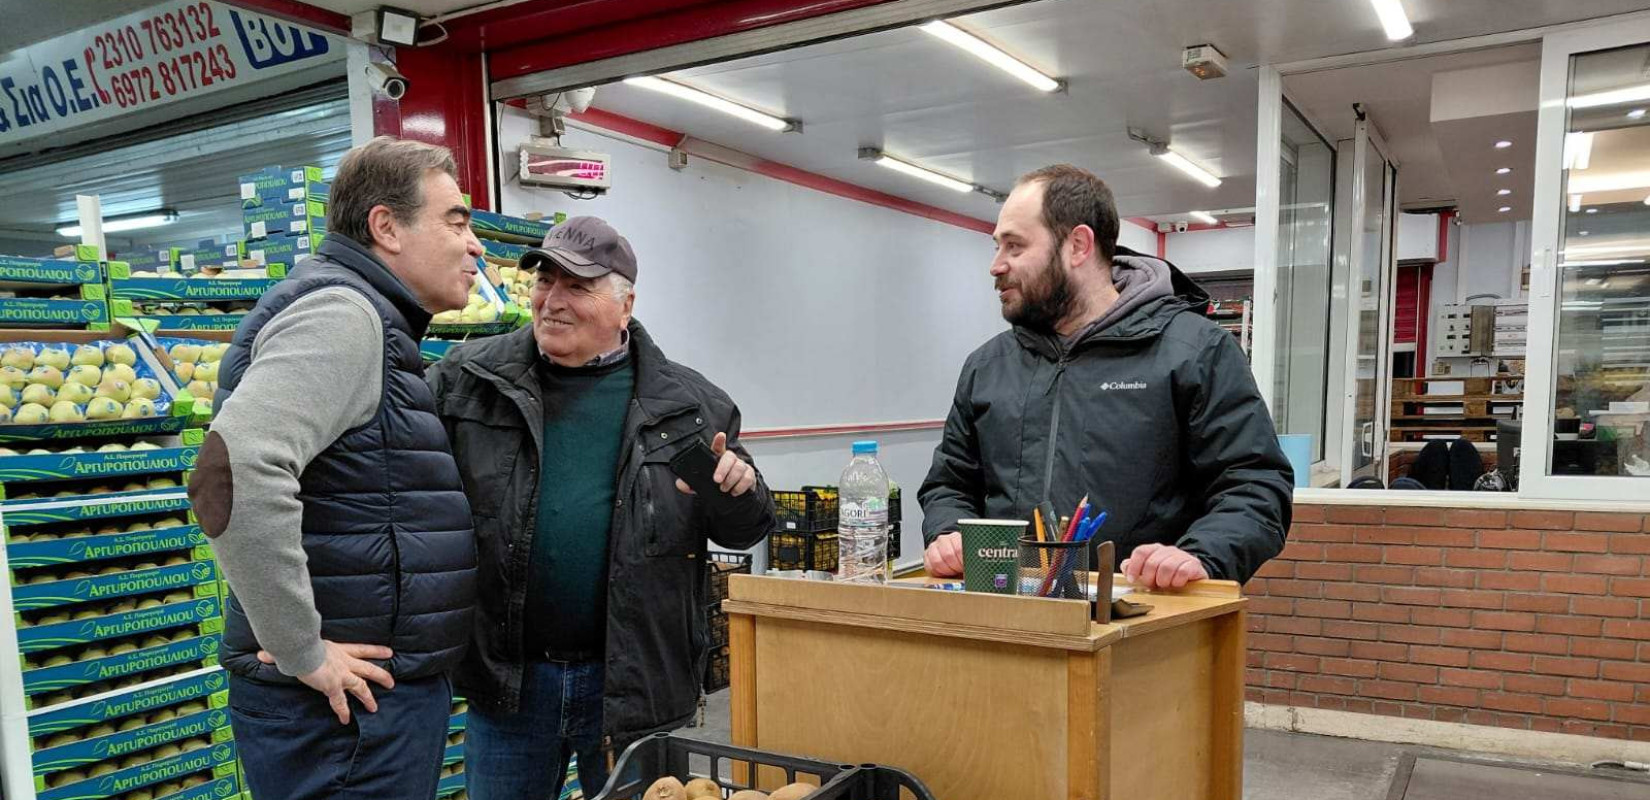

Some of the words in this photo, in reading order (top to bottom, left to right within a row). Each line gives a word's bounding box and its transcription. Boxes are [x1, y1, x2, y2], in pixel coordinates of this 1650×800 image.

[95, 25, 143, 69] 2310
[140, 2, 221, 54] 763132
[0, 76, 50, 127] Σια
[111, 66, 161, 108] 6972
[158, 44, 236, 95] 817243
[1109, 381, 1147, 390] Columbia
